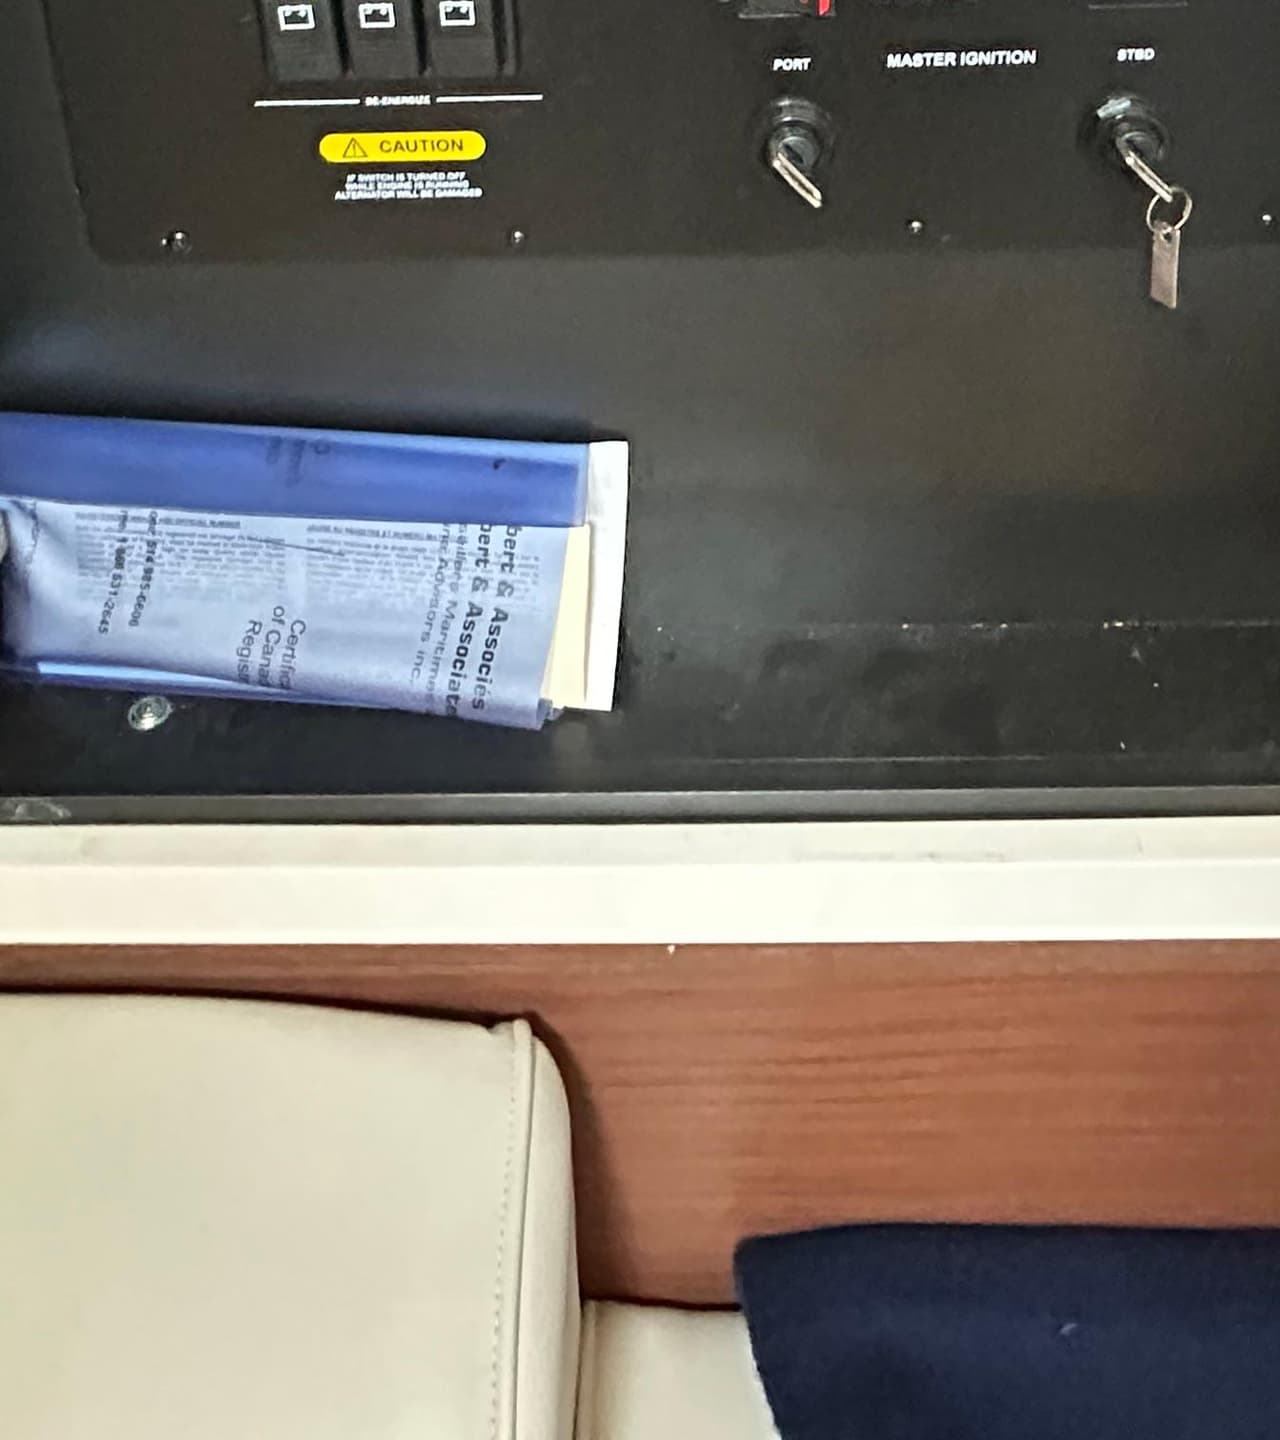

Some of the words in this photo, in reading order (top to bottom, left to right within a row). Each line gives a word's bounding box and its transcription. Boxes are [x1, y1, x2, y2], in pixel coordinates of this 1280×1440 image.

[886, 51, 956, 69] MASTER
[960, 49, 1037, 67] IGNITION
[1116, 48, 1155, 62] STBD
[772, 57, 811, 71] PORT
[380, 139, 464, 153] CAUTION
[471, 576, 489, 593] &
[496, 580, 514, 598] &
[272, 606, 285, 626] of
